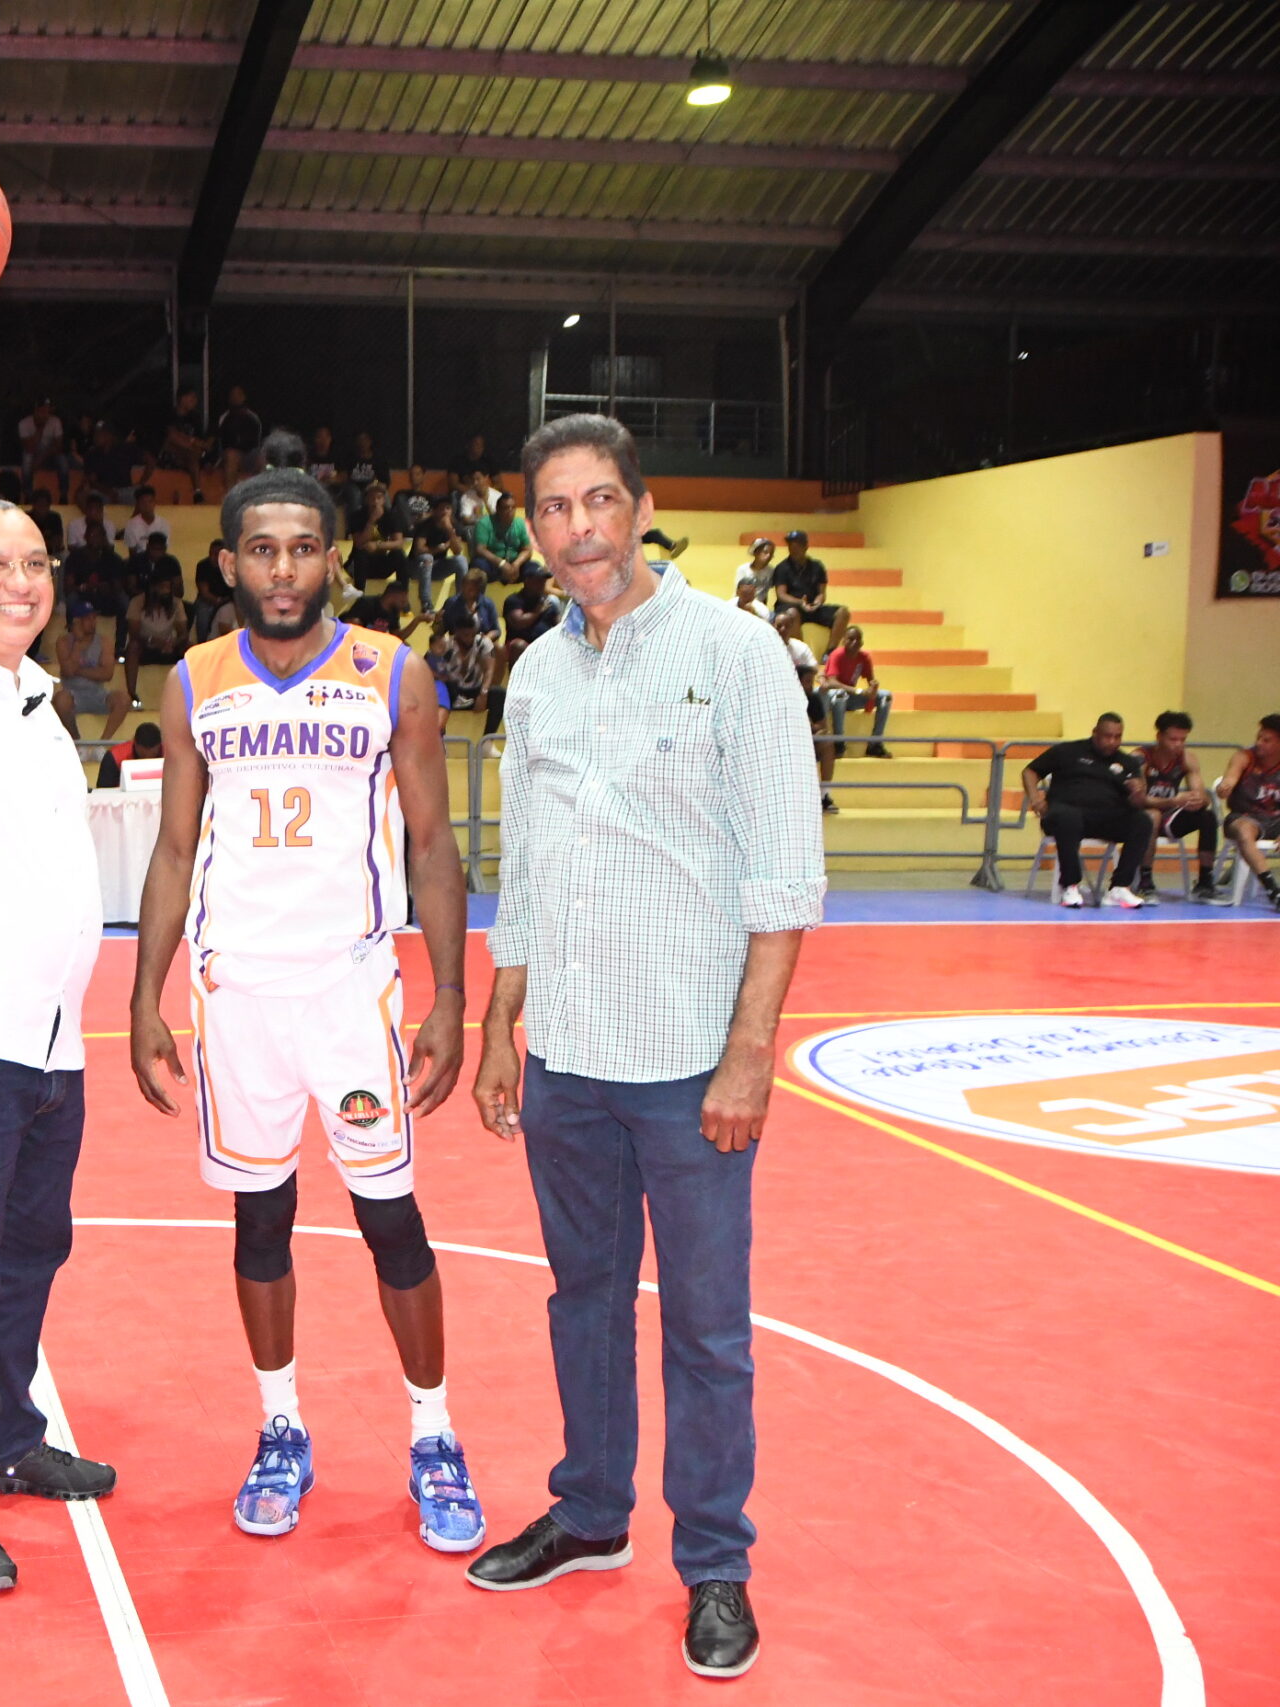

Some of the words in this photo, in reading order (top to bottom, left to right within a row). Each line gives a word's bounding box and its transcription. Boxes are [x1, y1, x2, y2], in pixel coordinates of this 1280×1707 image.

[201, 722, 370, 763] REMANSO
[236, 763, 297, 773] DEPORTIVO
[250, 787, 312, 847] 12
